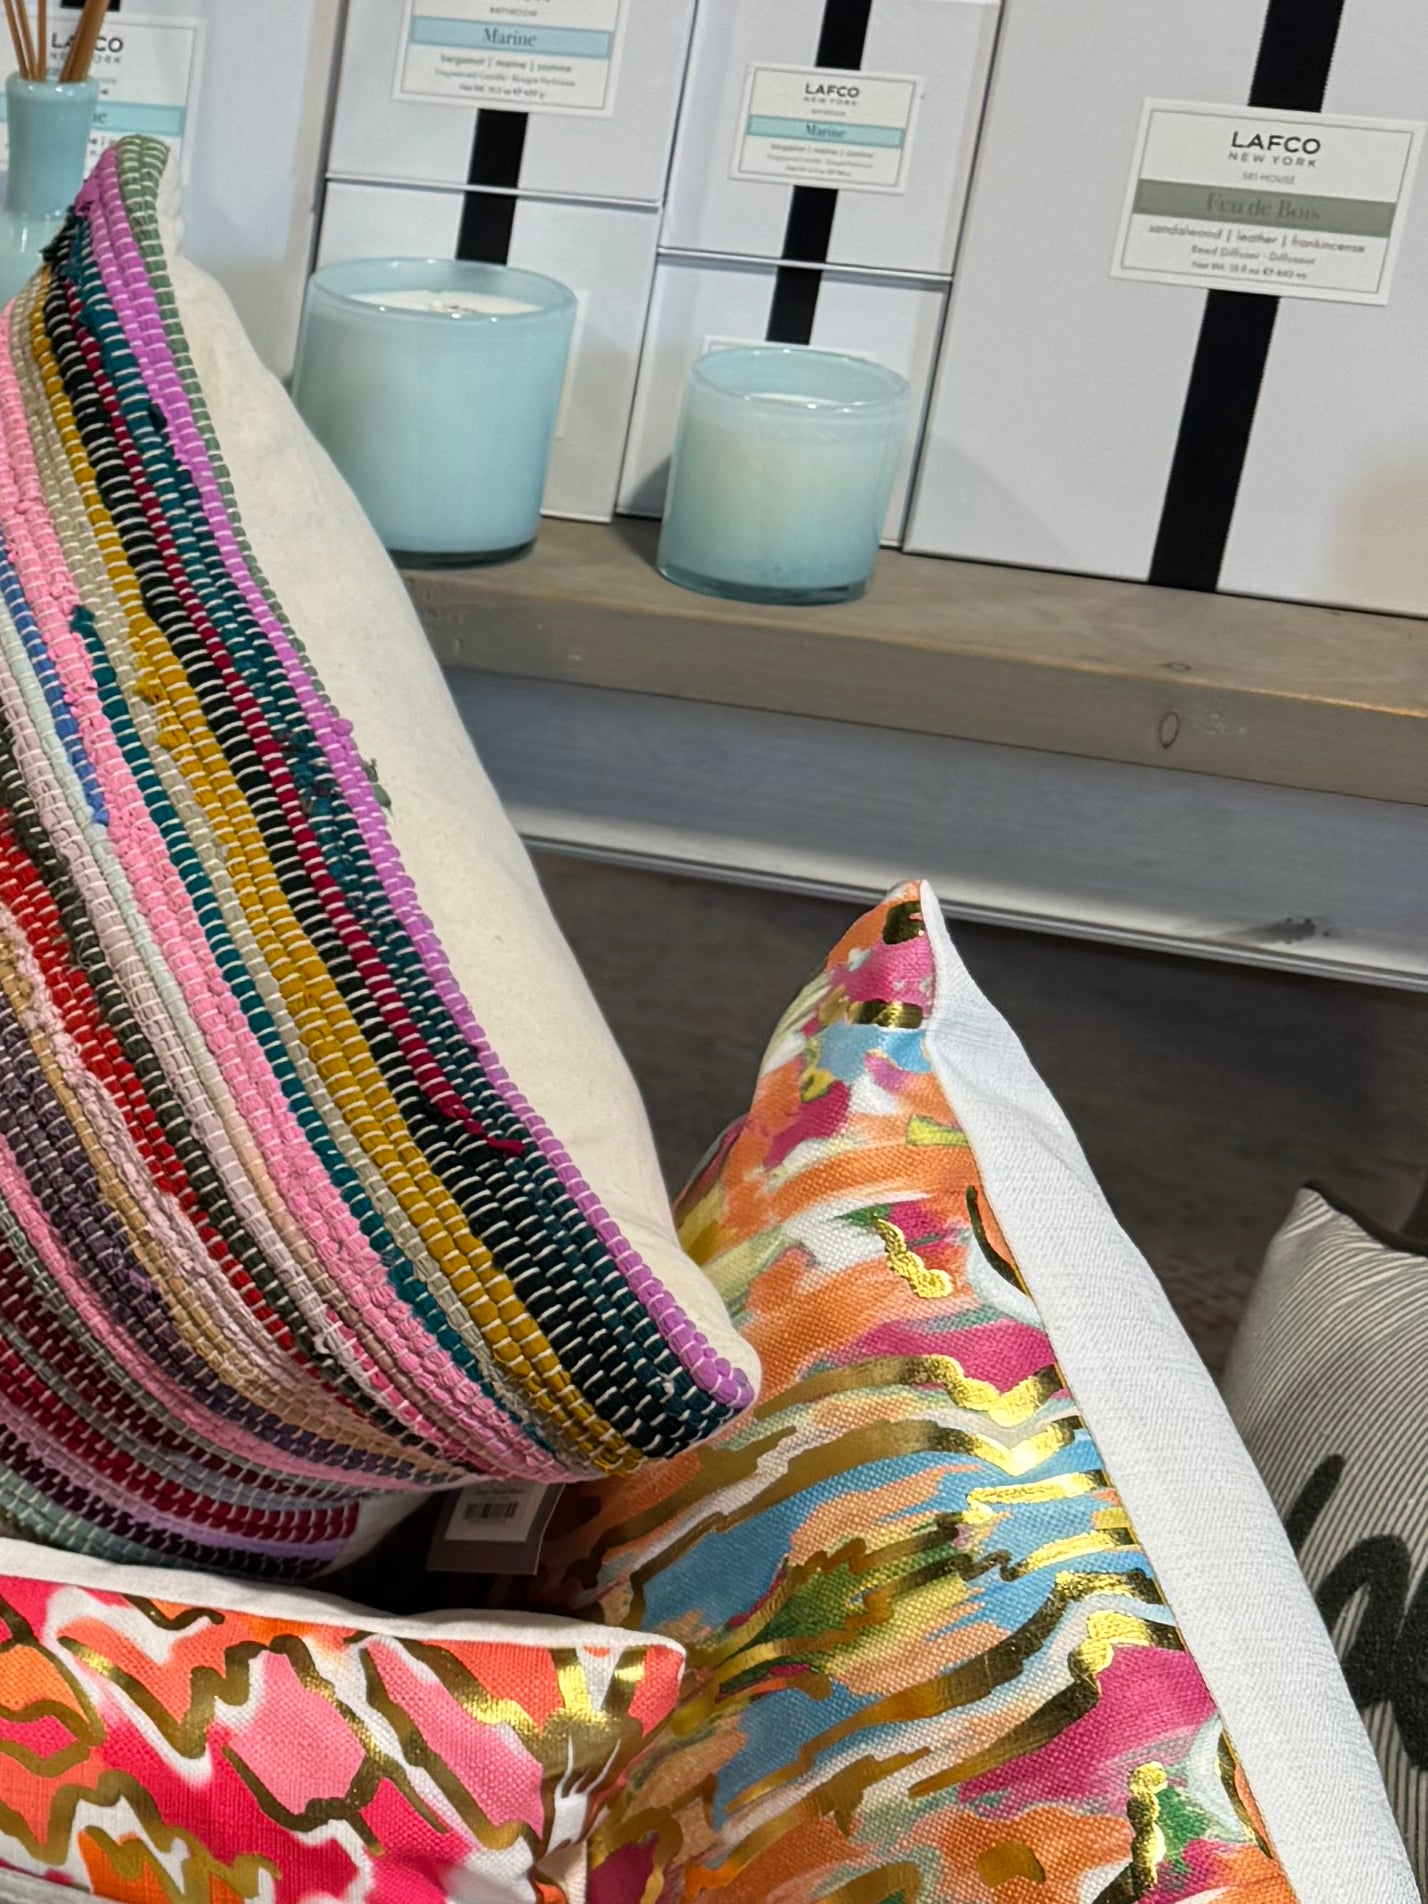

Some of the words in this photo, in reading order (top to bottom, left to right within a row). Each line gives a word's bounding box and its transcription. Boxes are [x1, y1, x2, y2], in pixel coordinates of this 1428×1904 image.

[51, 32, 124, 53] LACO
[482, 27, 537, 47] Marine
[805, 83, 860, 98] LAFCO
[1231, 131, 1321, 155] LAFCO
[1228, 151, 1264, 164] NEW
[1272, 154, 1317, 168] YORK
[1205, 192, 1244, 214] Feu
[1247, 197, 1271, 217] de
[1277, 199, 1320, 221] Bois
[1148, 223, 1223, 241] sandalwood
[1236, 230, 1278, 246] leather
